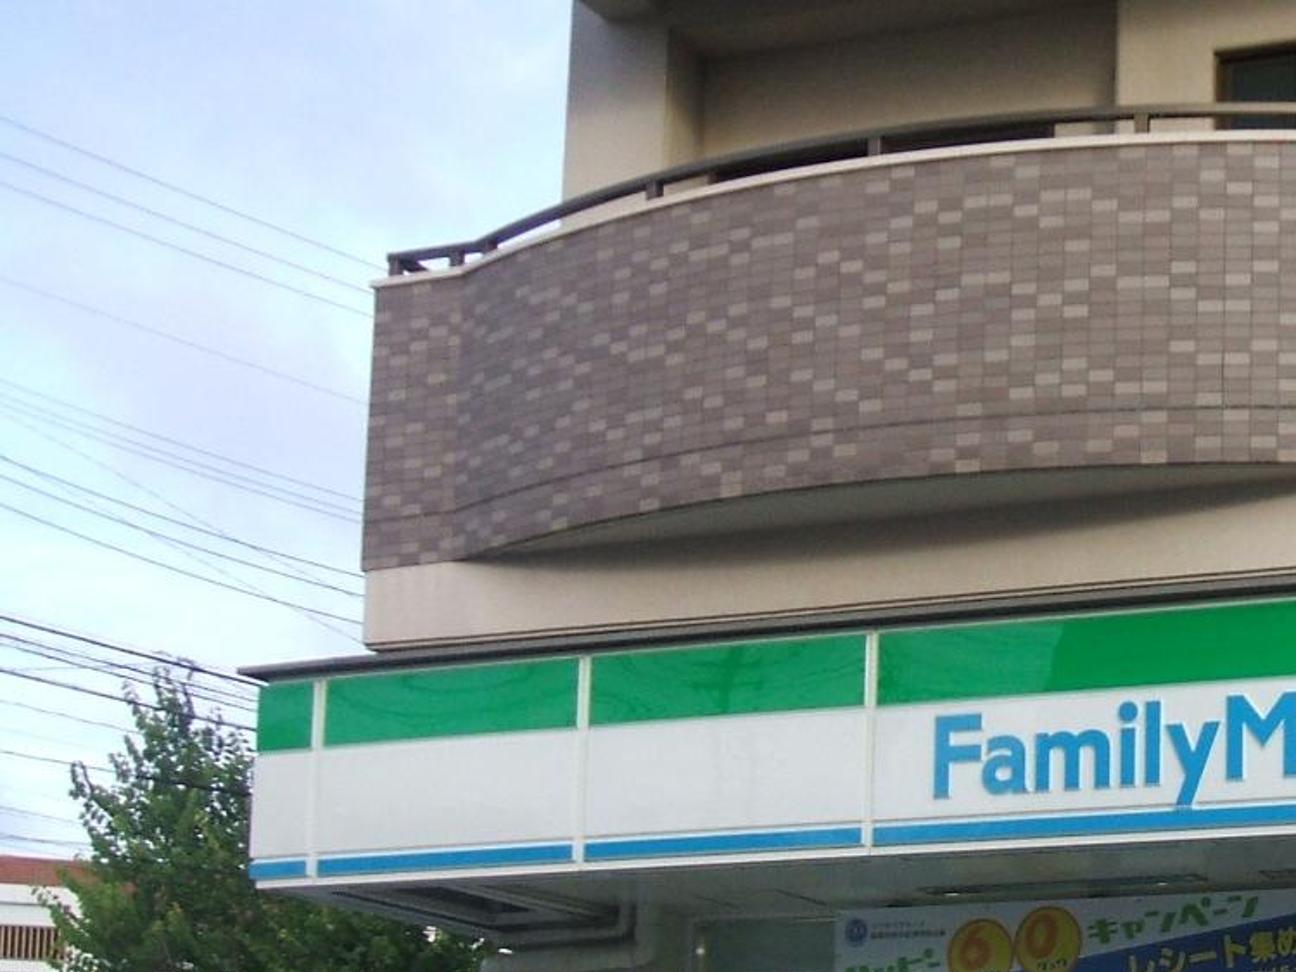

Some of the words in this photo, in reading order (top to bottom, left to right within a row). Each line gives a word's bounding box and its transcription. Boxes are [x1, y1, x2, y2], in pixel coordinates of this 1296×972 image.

[1088, 896, 1259, 944] キャンペーン
